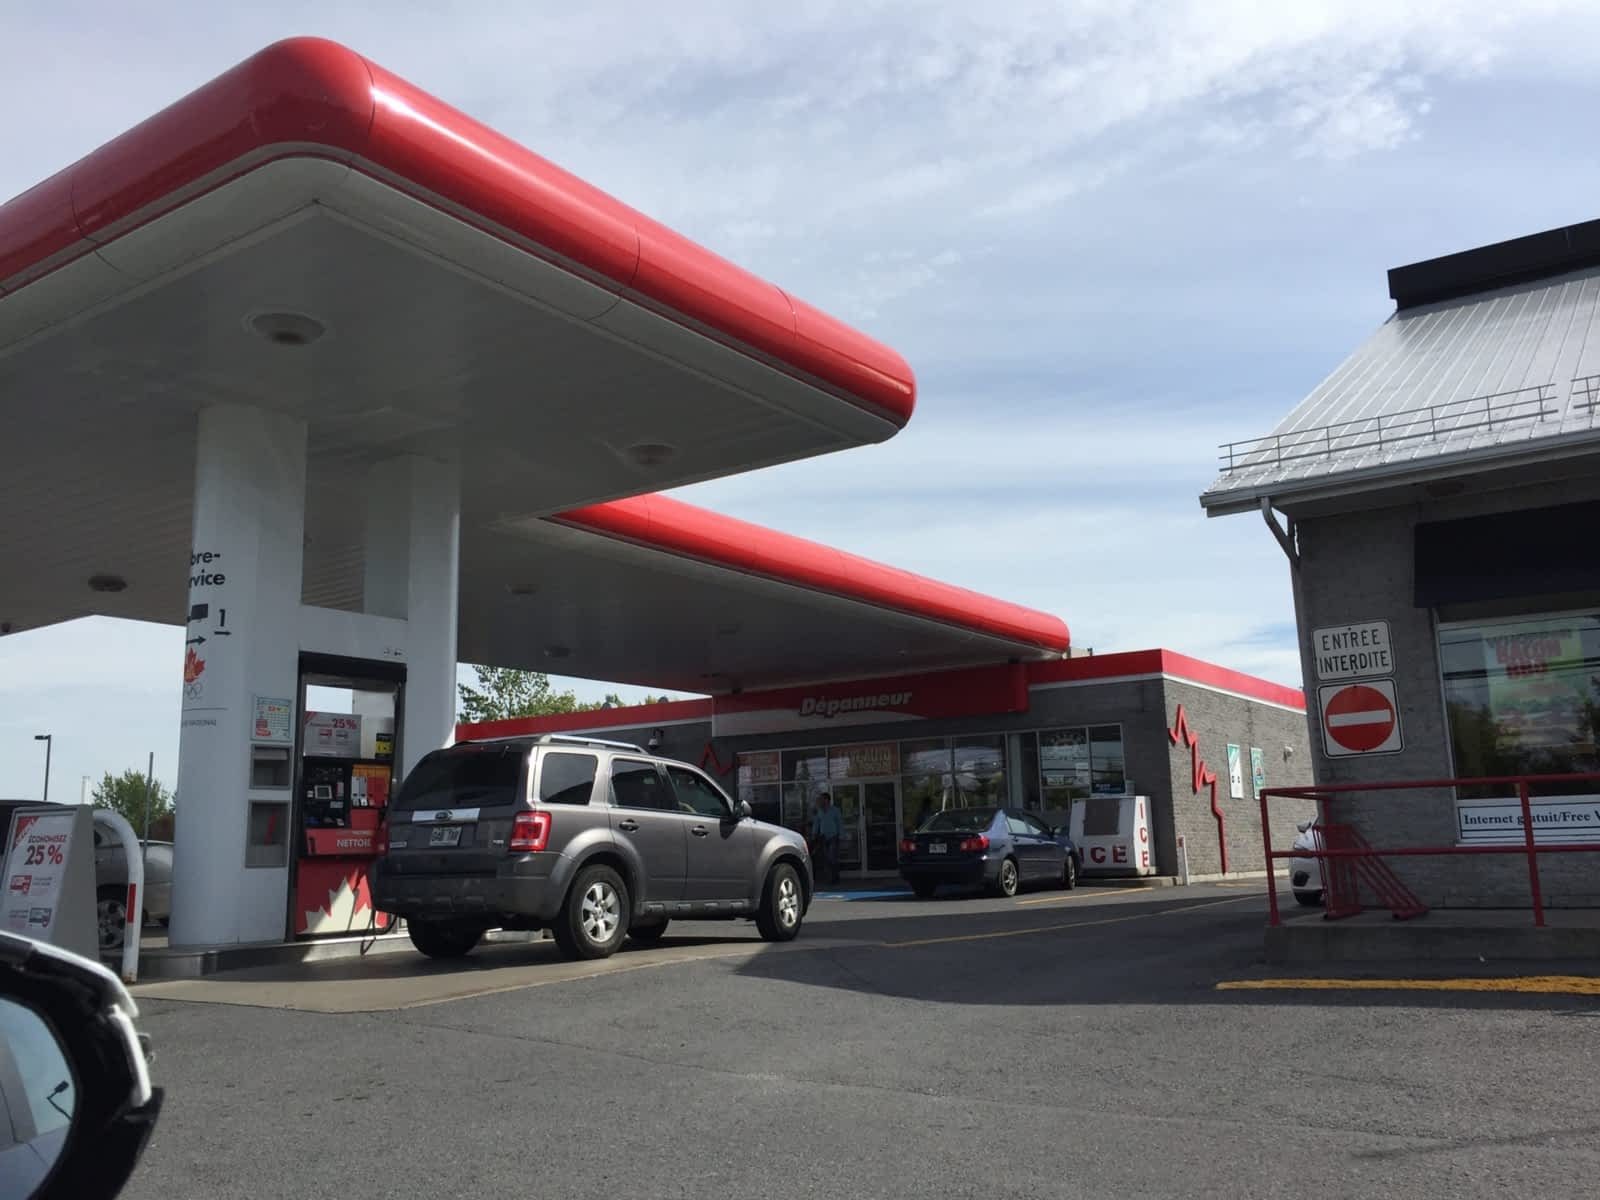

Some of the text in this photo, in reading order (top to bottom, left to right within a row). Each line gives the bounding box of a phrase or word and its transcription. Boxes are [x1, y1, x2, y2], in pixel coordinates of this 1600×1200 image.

[219, 608, 226, 627] 1
[1319, 650, 1389, 673] INTERDITE
[1464, 814, 1513, 825] Internet
